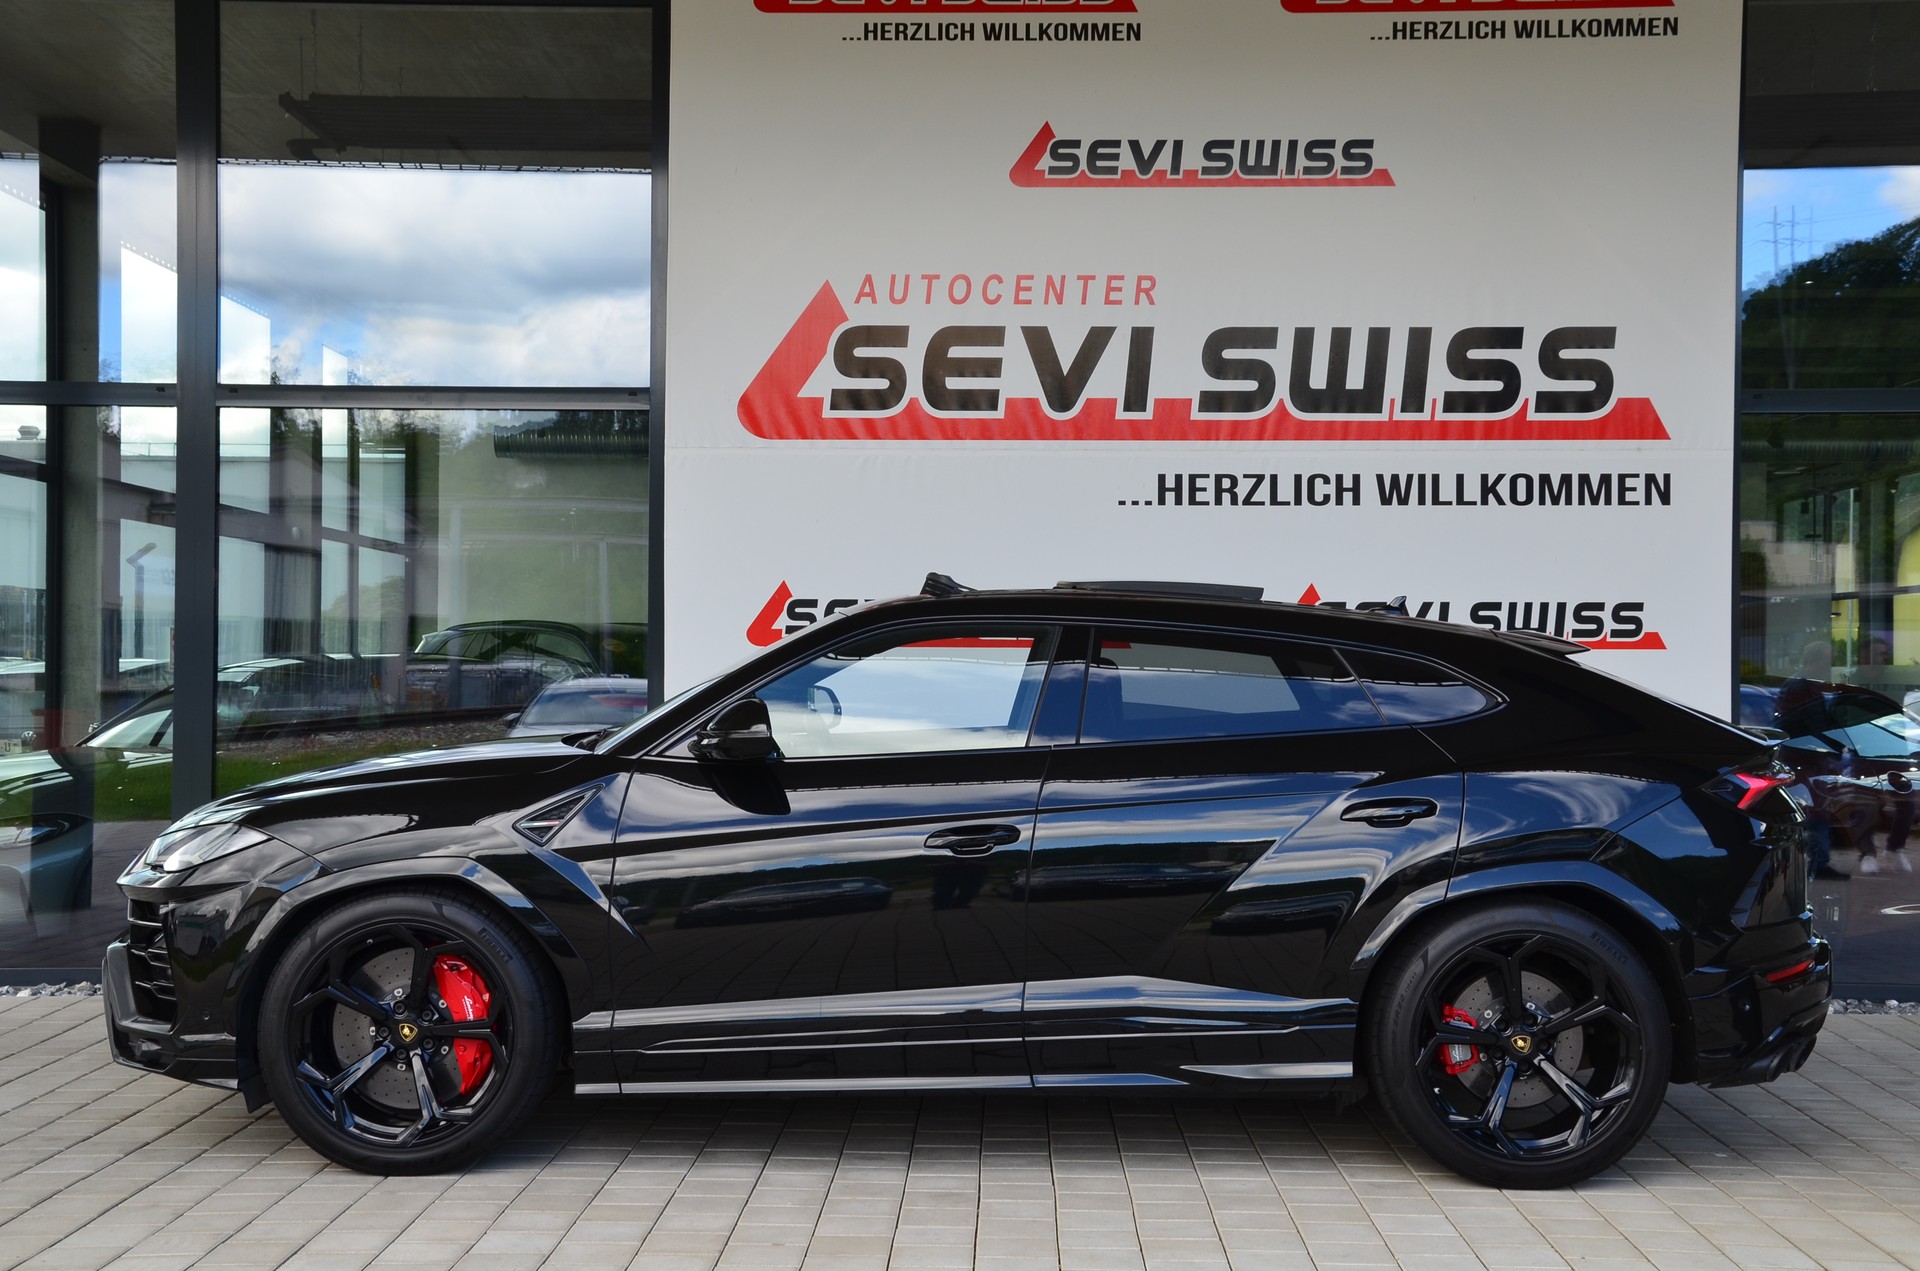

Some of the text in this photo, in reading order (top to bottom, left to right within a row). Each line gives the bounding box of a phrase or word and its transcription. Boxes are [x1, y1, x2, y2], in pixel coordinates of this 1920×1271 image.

[842, 22, 1142, 42] ...HERZLICH WILLKOMMEN
[1370, 16, 1679, 41] ...HERZLICH WILLKOMMEN
[1046, 138, 1375, 178] SEVI SWISS
[853, 273, 1157, 306] AUTOCENTER
[829, 324, 1618, 414] SEVI SWISS
[1117, 472, 1671, 507] ...HERZLICH WILLKOMMEN
[1469, 601, 1645, 639] SWISS
